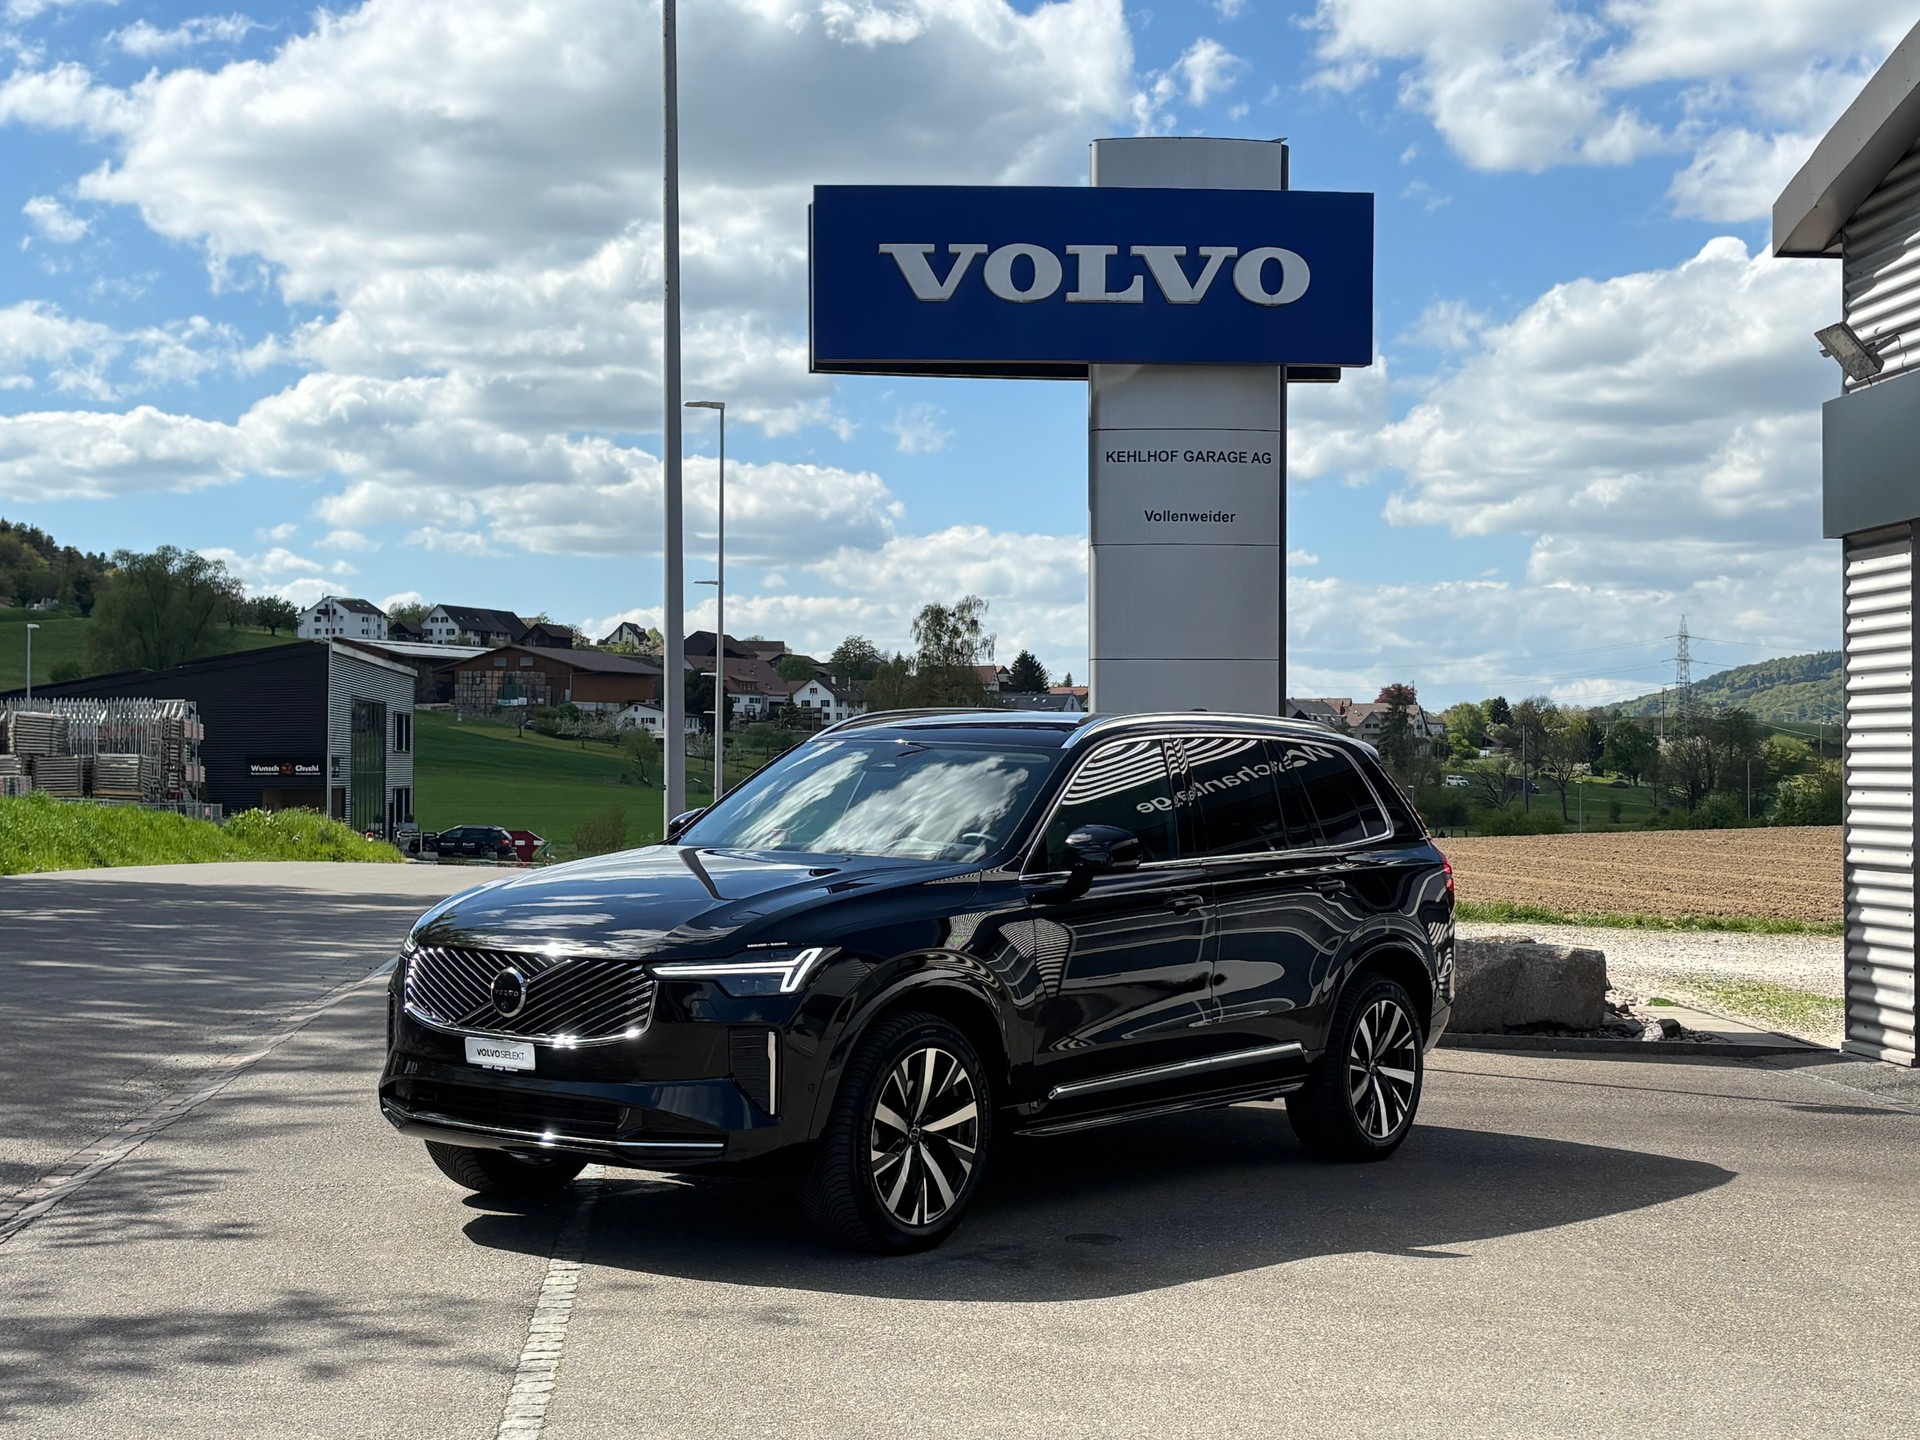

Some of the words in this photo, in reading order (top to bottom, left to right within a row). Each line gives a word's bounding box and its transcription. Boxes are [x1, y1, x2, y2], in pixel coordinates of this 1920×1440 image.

[878, 242, 1311, 306] VOLVO
[1105, 450, 1179, 463] KEHLHOF
[1183, 450, 1248, 463] GARAGE
[1251, 452, 1272, 464] AG
[1144, 510, 1236, 523] Vollenweider
[250, 764, 280, 772] Wunsch
